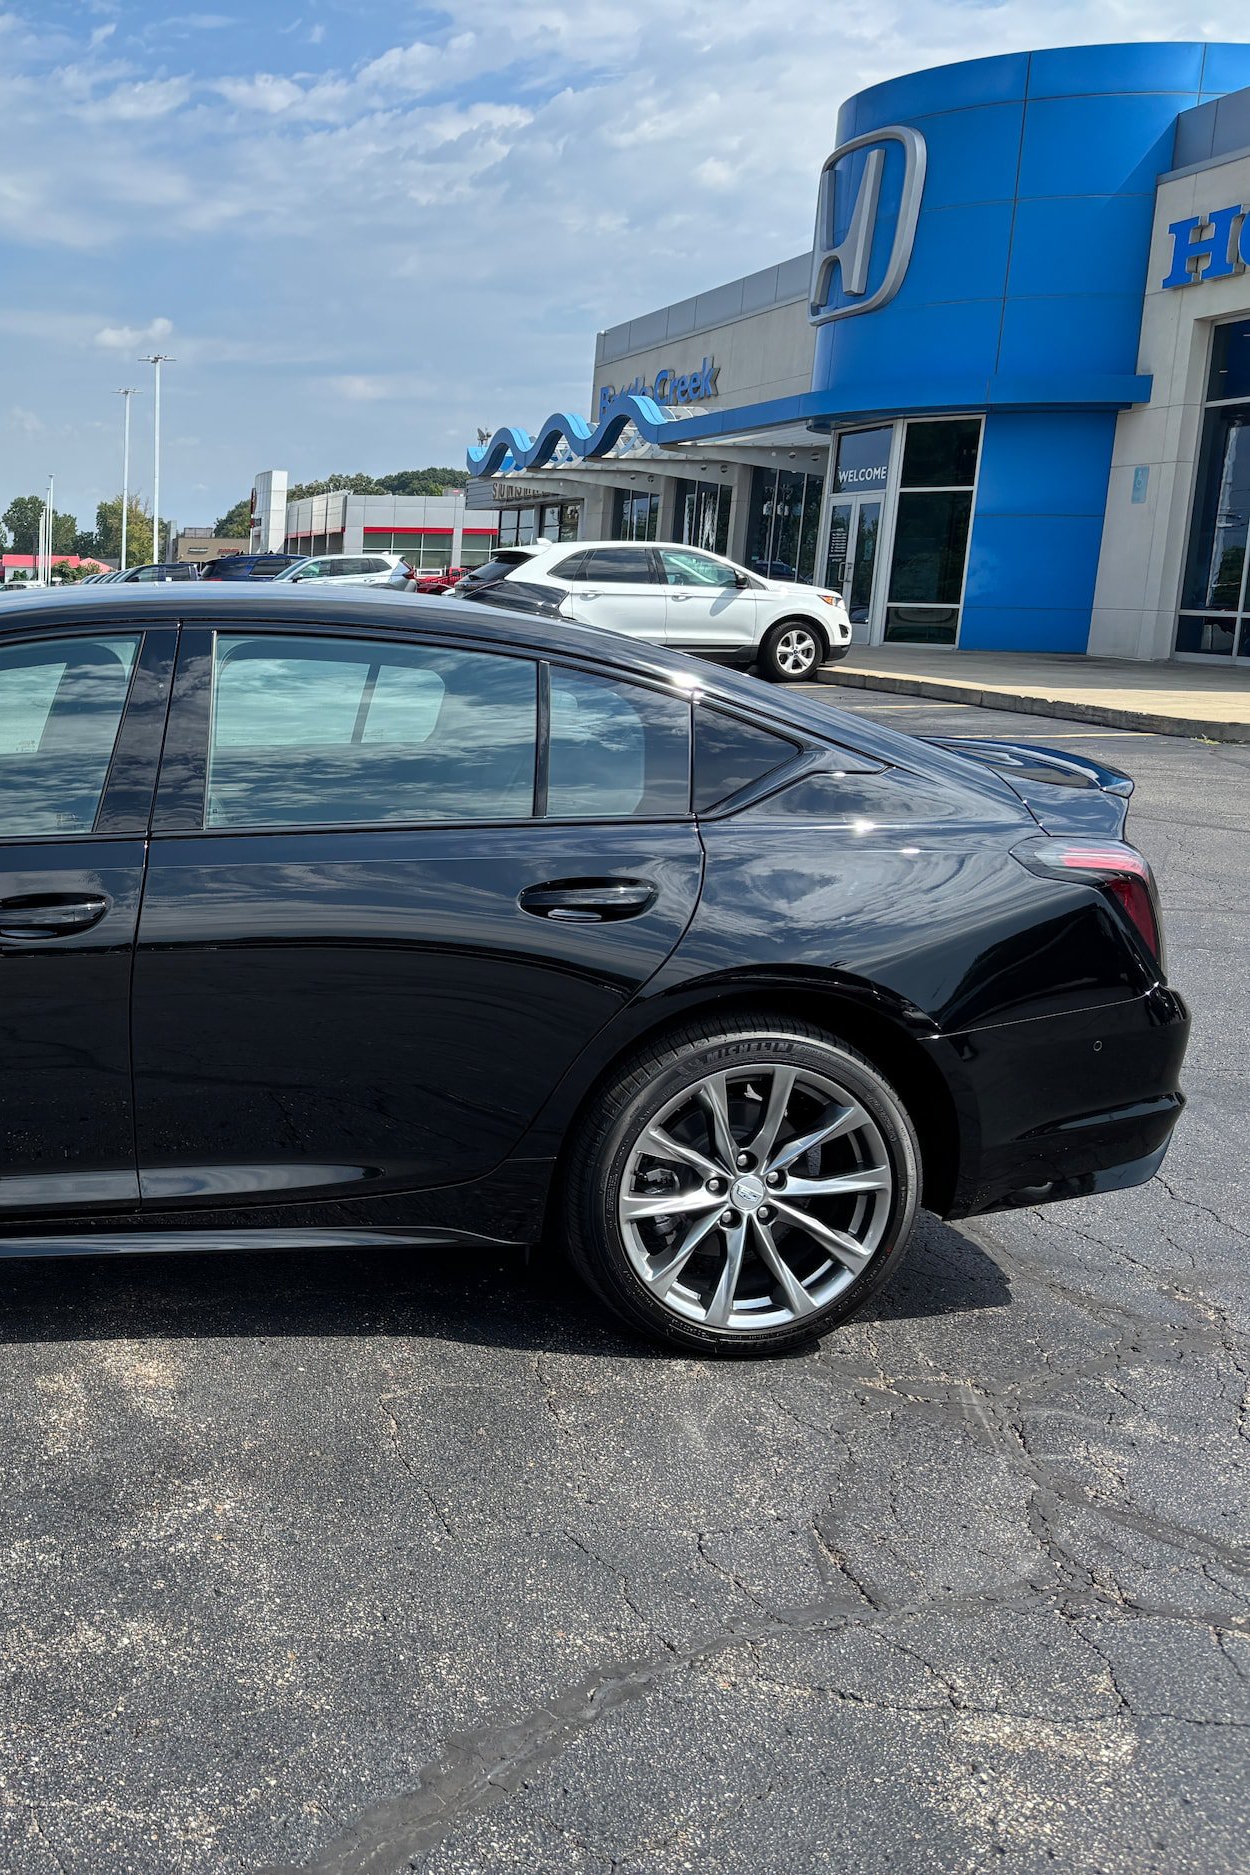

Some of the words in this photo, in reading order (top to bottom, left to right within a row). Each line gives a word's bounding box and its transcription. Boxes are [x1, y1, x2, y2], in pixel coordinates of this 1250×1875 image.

[1161, 204, 1250, 289] H
[654, 356, 720, 406] Creek
[838, 466, 888, 483] WELCOME
[706, 1042, 791, 1062] MICHELIN
